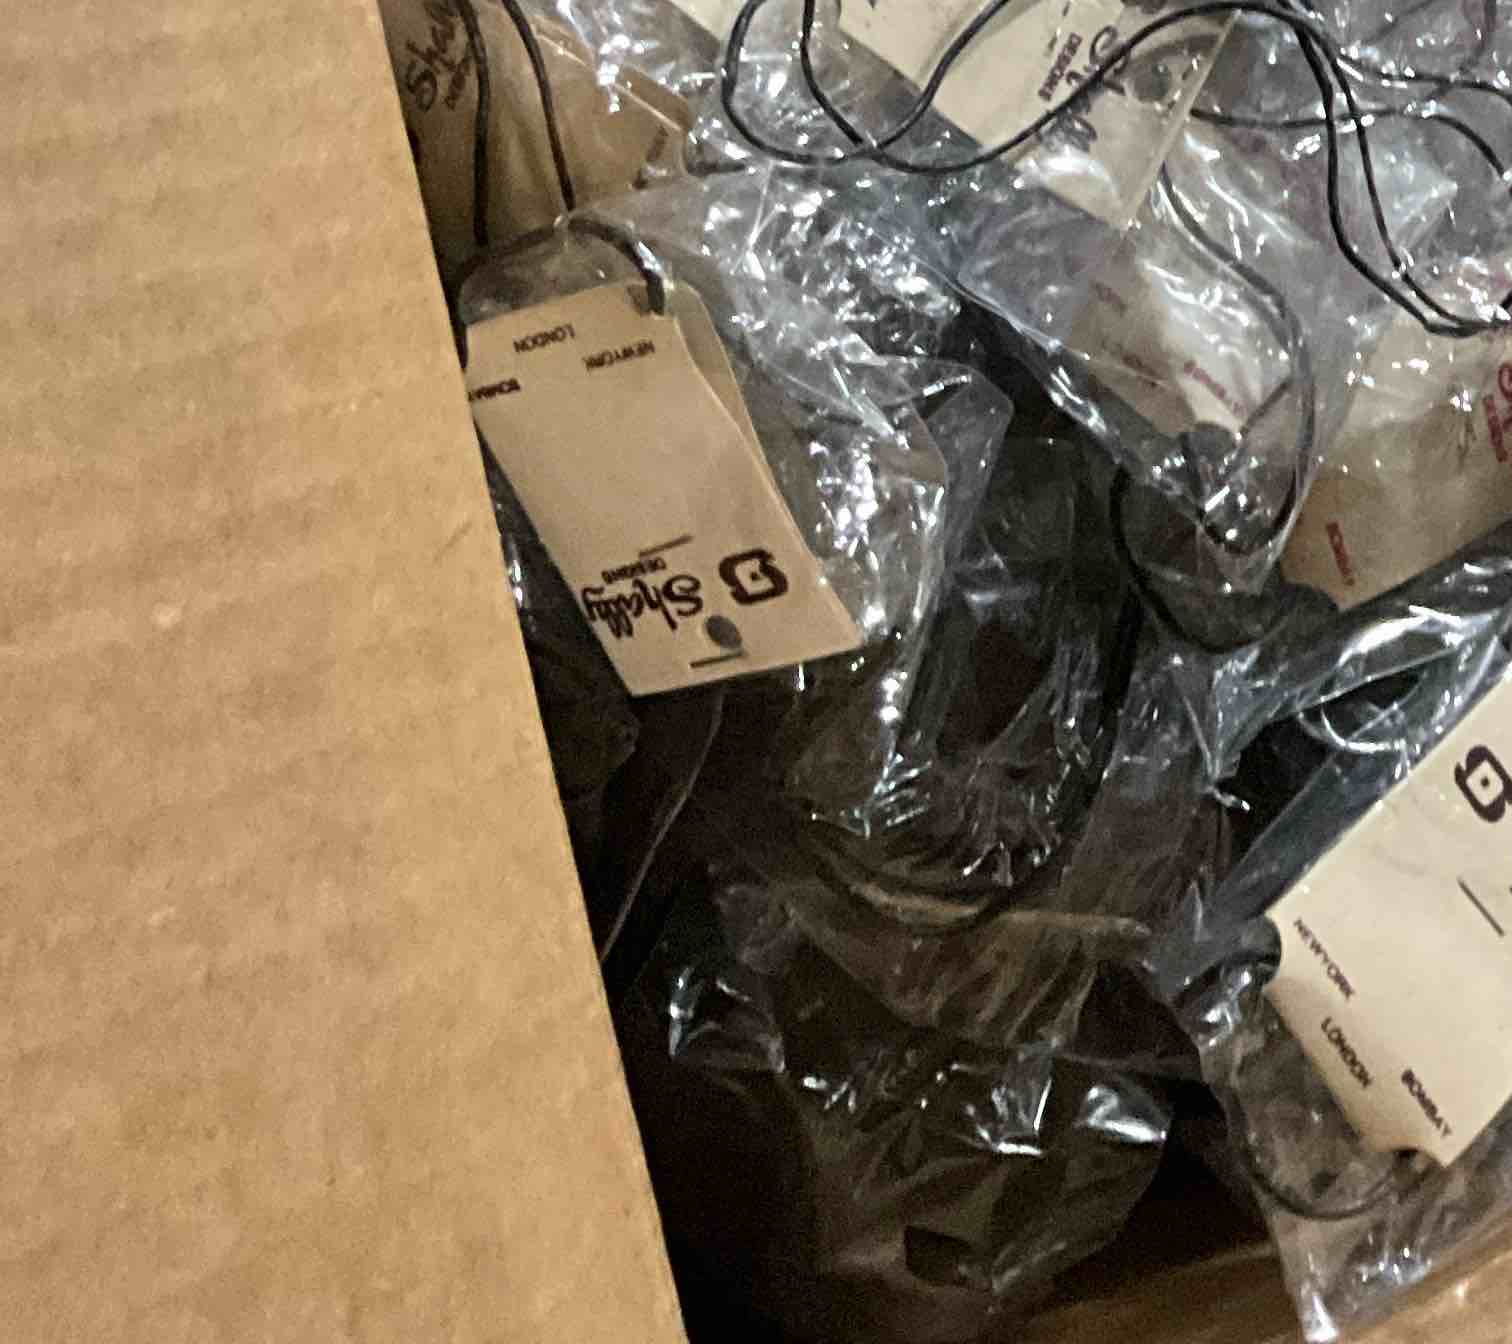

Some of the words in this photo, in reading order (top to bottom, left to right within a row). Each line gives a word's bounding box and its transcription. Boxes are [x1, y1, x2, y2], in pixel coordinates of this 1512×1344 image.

[513, 322, 576, 354] LONDON
[582, 340, 656, 371] NEWYORK
[580, 573, 704, 640] Shally
[1292, 917, 1356, 1002] NEWYORK
[1320, 1016, 1374, 1089] LONDON
[1400, 1068, 1453, 1139] BOMBAY
